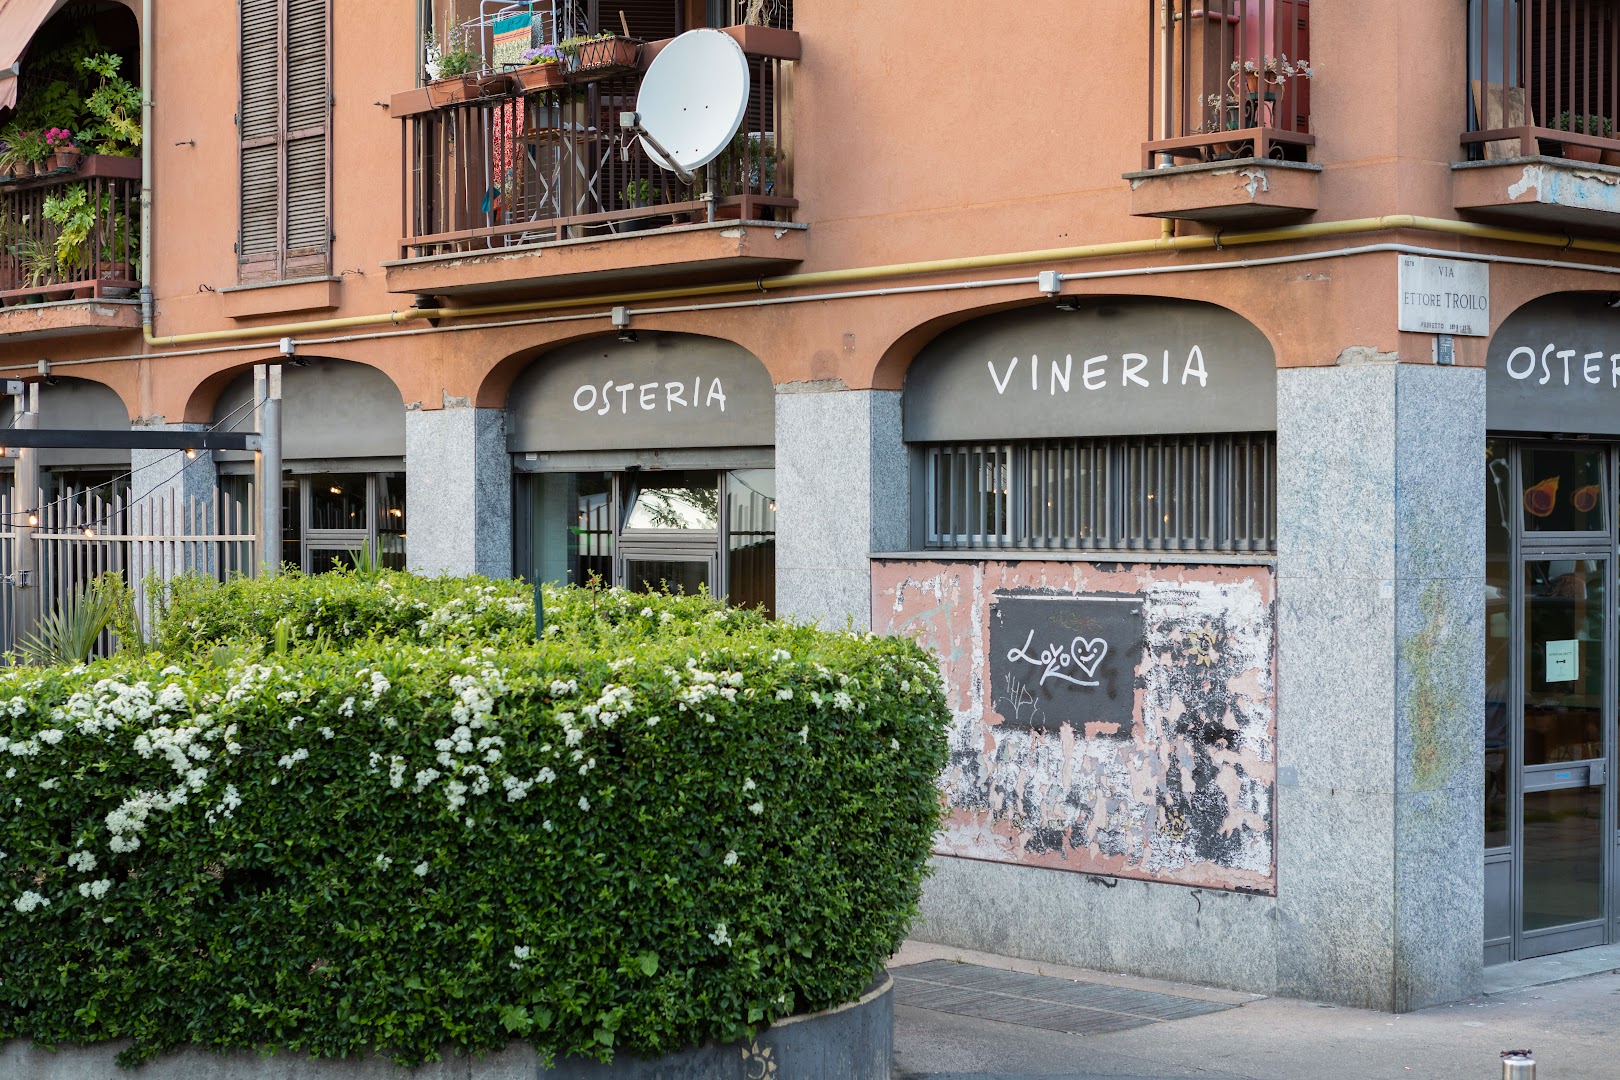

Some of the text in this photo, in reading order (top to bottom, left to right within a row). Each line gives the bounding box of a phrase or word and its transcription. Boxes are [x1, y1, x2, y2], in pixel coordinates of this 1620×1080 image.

[1438, 266, 1454, 278] VIA
[1404, 292, 1488, 311] ETTORE TROILO
[987, 345, 1208, 396] VINERIA
[573, 376, 727, 416] OSTERIA
